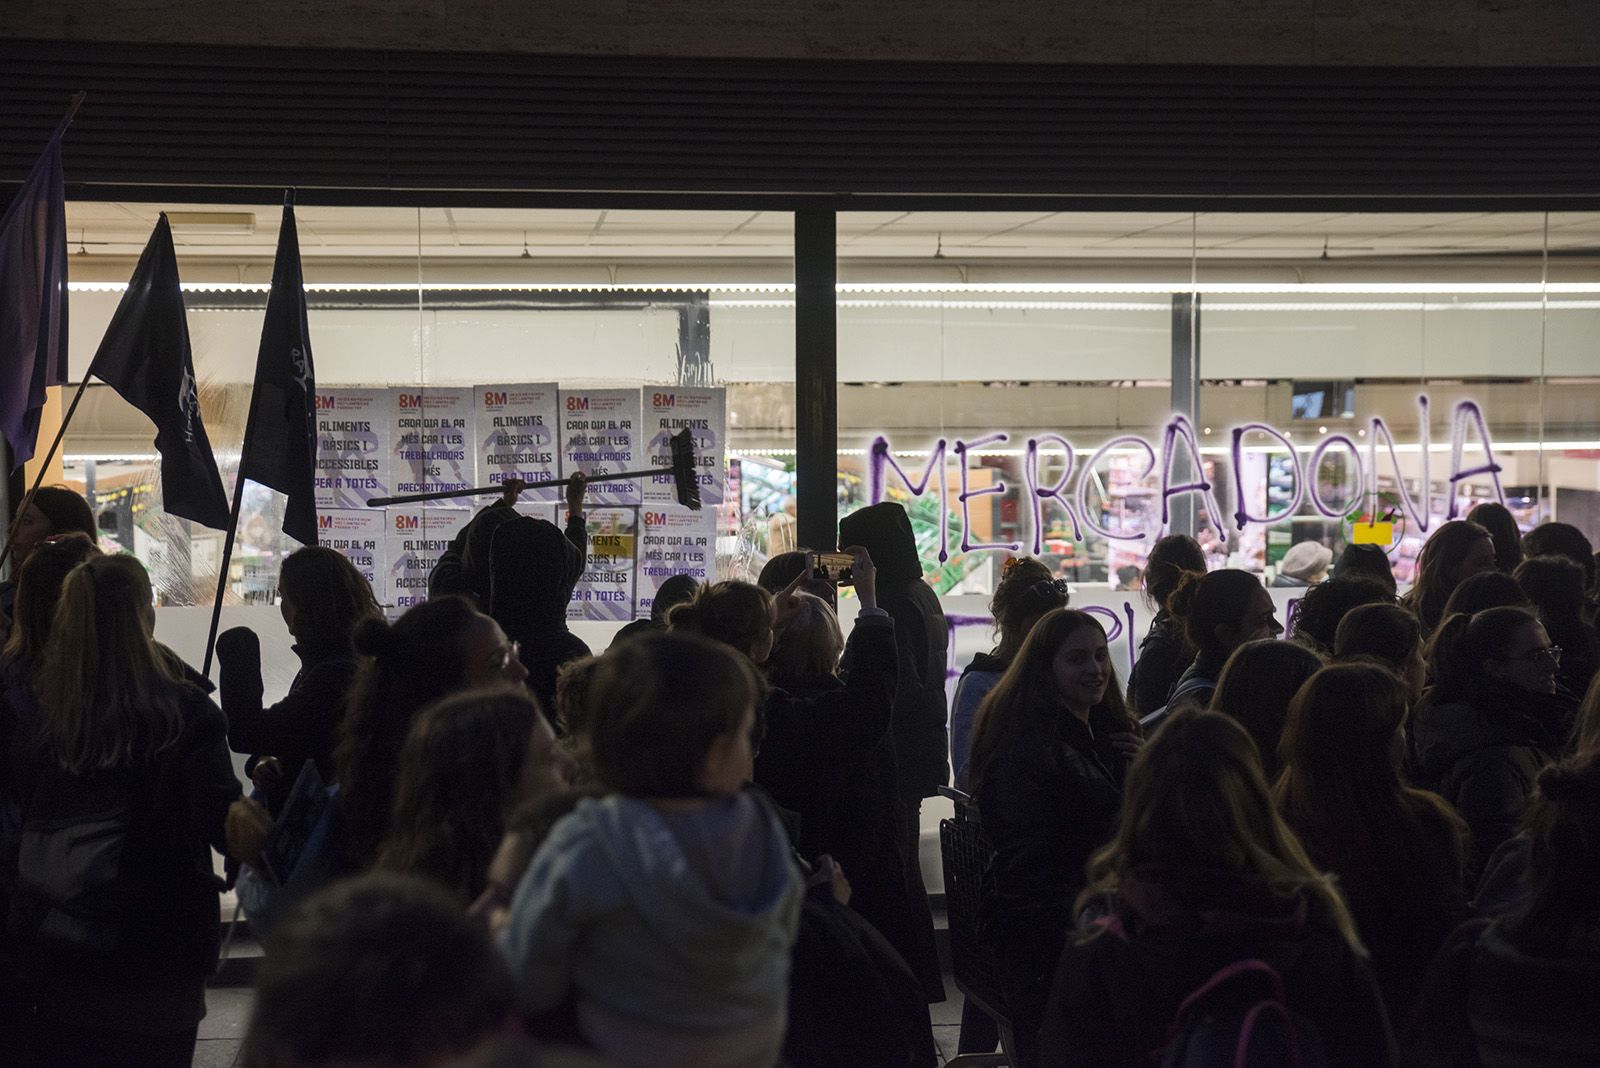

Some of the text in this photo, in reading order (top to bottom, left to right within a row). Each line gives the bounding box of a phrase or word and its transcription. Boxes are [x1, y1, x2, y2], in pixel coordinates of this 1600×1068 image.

[399, 394, 422, 408] 8M
[484, 391, 508, 406] 8M
[566, 396, 589, 410] 8M
[653, 393, 675, 407] 8M
[320, 421, 370, 432] ALIMENTS
[398, 418, 465, 428] CADA DIA EL PA
[493, 415, 543, 428] ALIMENTS
[566, 420, 632, 430] CADA DIA EL PA
[660, 418, 709, 430] ALIMENTS
[322, 436, 367, 451] BÀSICS I
[401, 432, 462, 444] MÉS CAR I LES
[496, 432, 541, 446] BÀSICS I
[569, 433, 629, 446] MÉS CAR I LES
[399, 451, 465, 460] TREBALLADORS
[487, 452, 552, 465] ACCESSIBLES
[568, 452, 632, 461] TREBALLADORS
[424, 464, 441, 476] MÉS
[521, 471, 552, 481] TOTES
[591, 465, 609, 476] MÉS
[335, 478, 342, 489] A
[345, 478, 377, 489] TOTES
[652, 474, 670, 484] PER
[868, 395, 1505, 563] MERCADONA
[397, 483, 467, 493] PRECARITZADES
[395, 514, 418, 529] 8M
[644, 511, 667, 526] 8M
[333, 539, 349, 549] DIA
[351, 540, 361, 550] EL
[364, 540, 376, 550] PA
[403, 540, 449, 551] ALIMENT
[643, 535, 707, 547] CADA DIA EL PA
[356, 556, 373, 566] LES
[645, 548, 704, 562] MÉS CAR I LES
[397, 596, 416, 607] PER
[585, 591, 592, 600] A
[596, 590, 625, 601] TOTES
